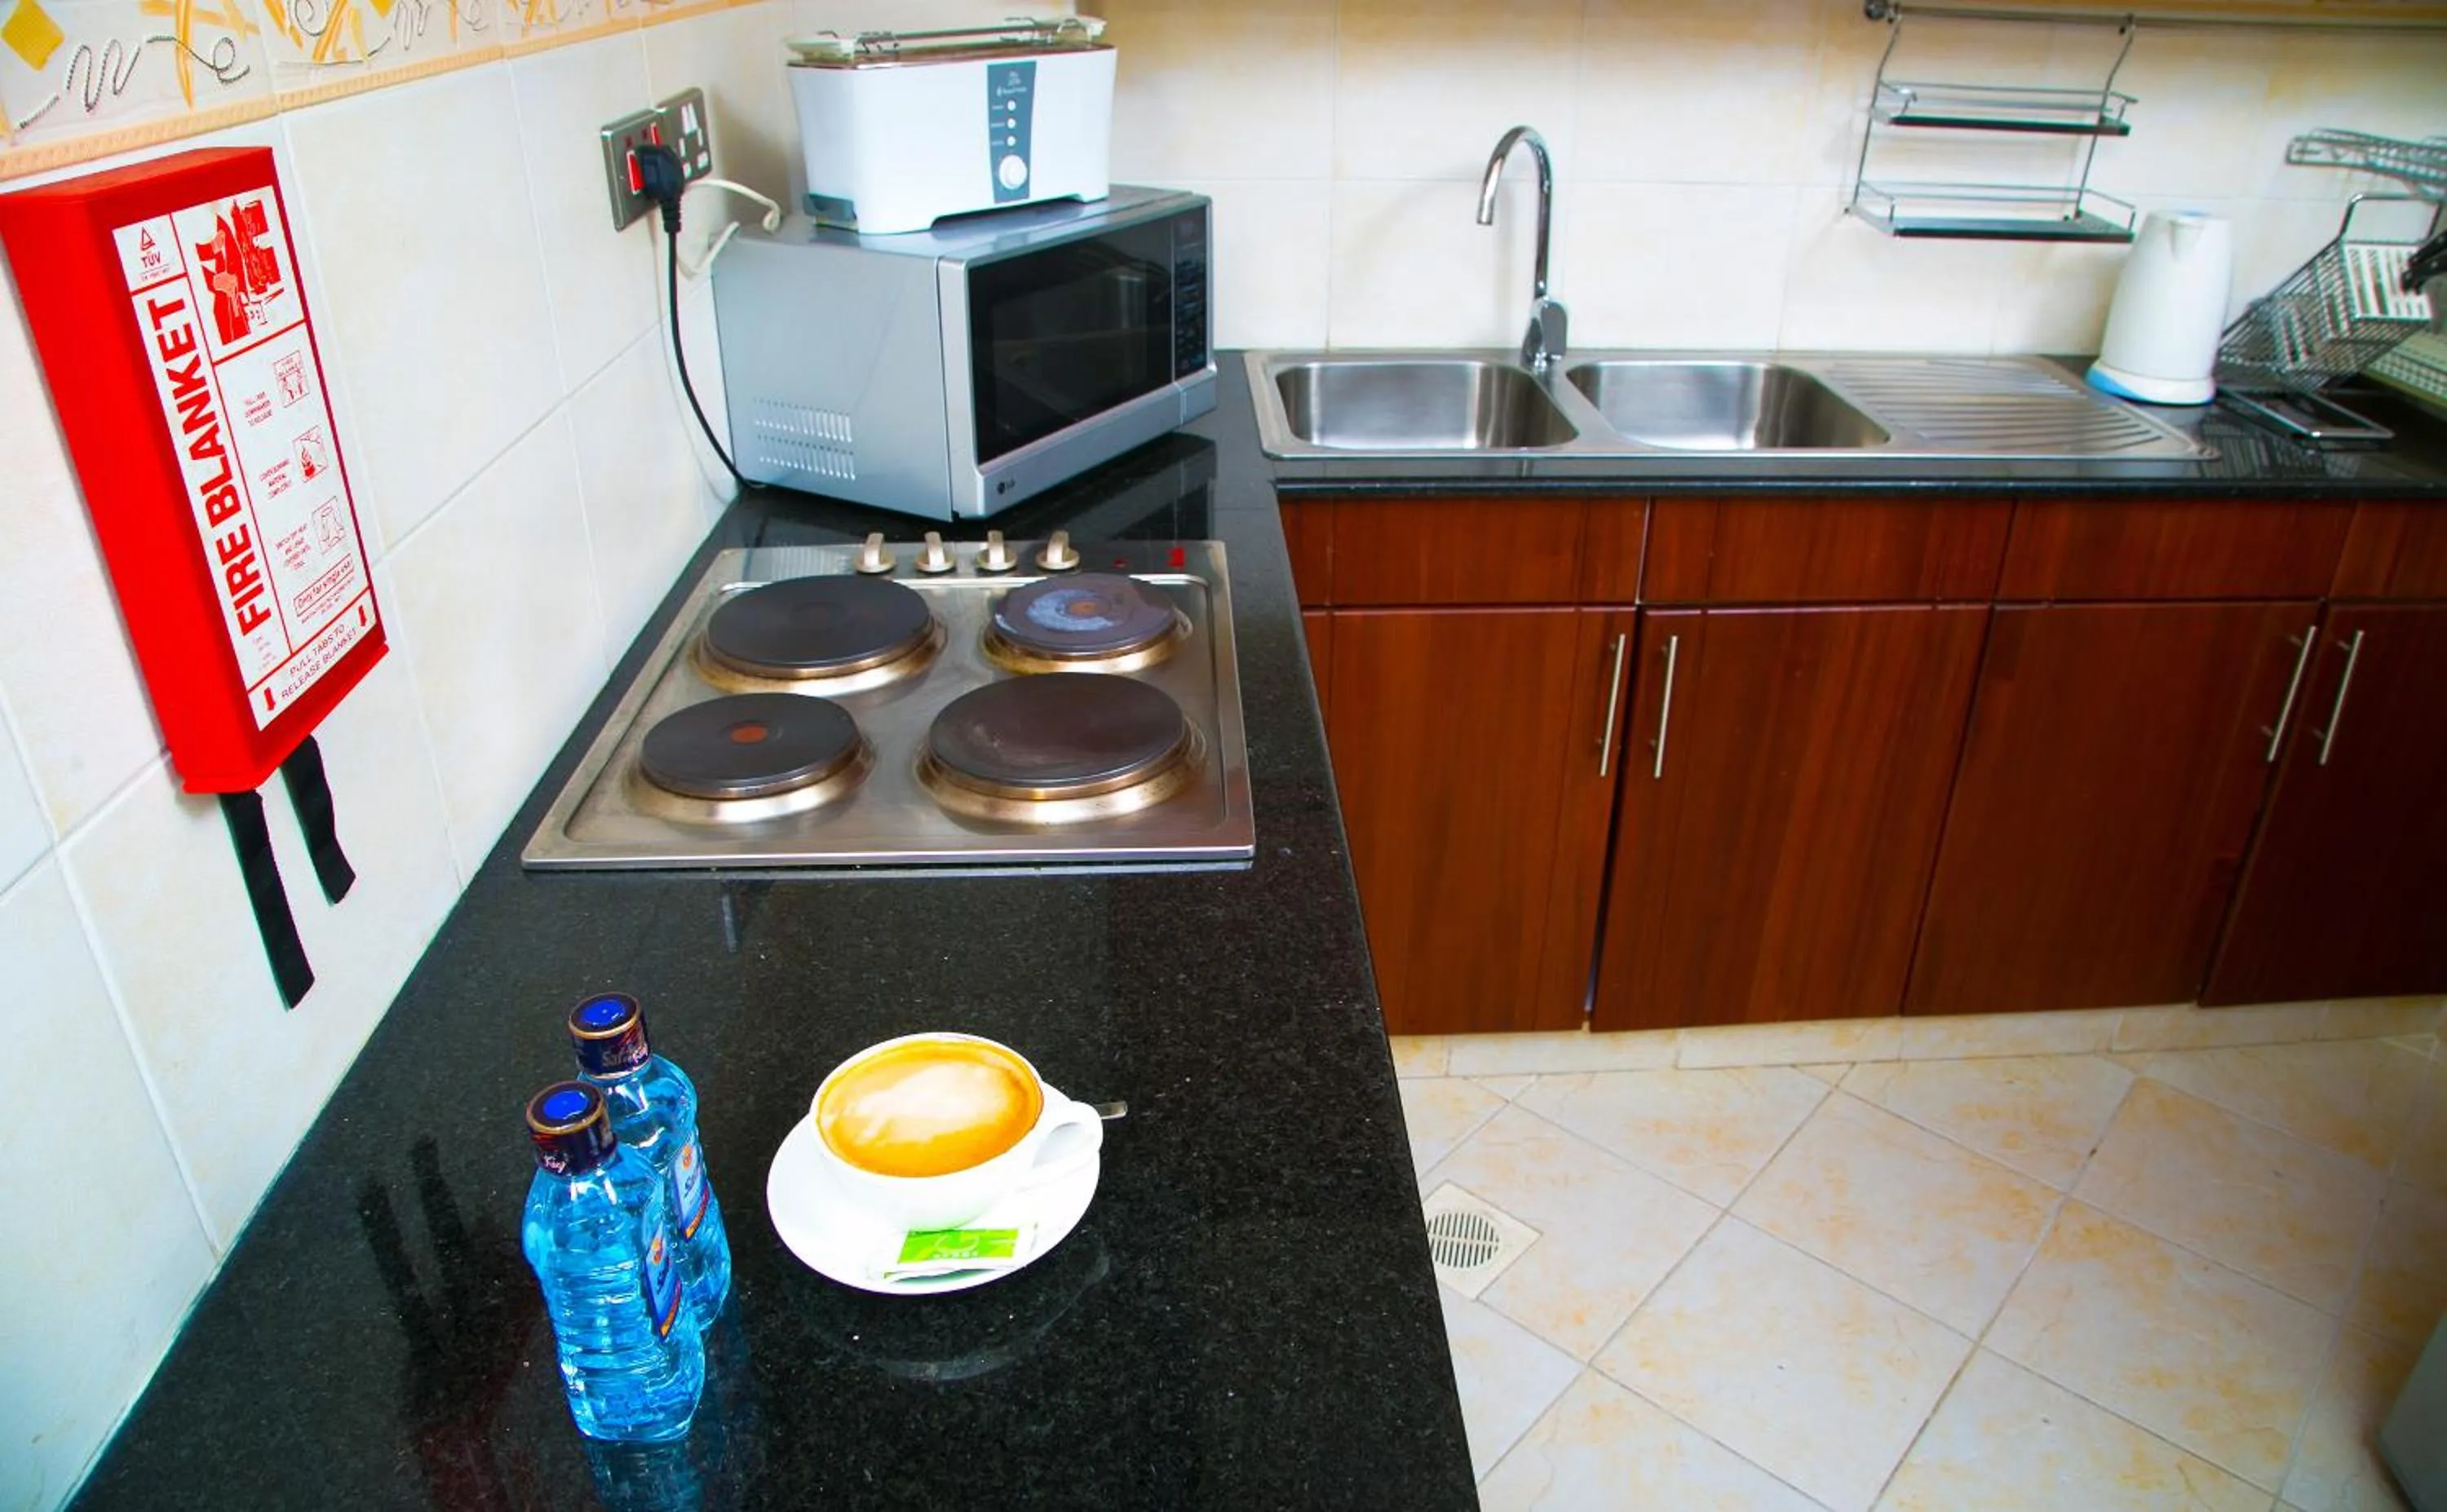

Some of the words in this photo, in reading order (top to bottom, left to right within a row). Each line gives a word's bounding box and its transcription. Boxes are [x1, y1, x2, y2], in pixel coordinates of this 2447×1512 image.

[140, 250, 162, 268] TÜV
[147, 298, 242, 528] BLANKET
[215, 523, 272, 636] FIRE
[281, 660, 321, 699] RELEASE
[322, 626, 356, 664] BLANKET
[289, 654, 312, 678] PULL
[312, 633, 334, 656] TABS
[333, 623, 345, 637] TO
